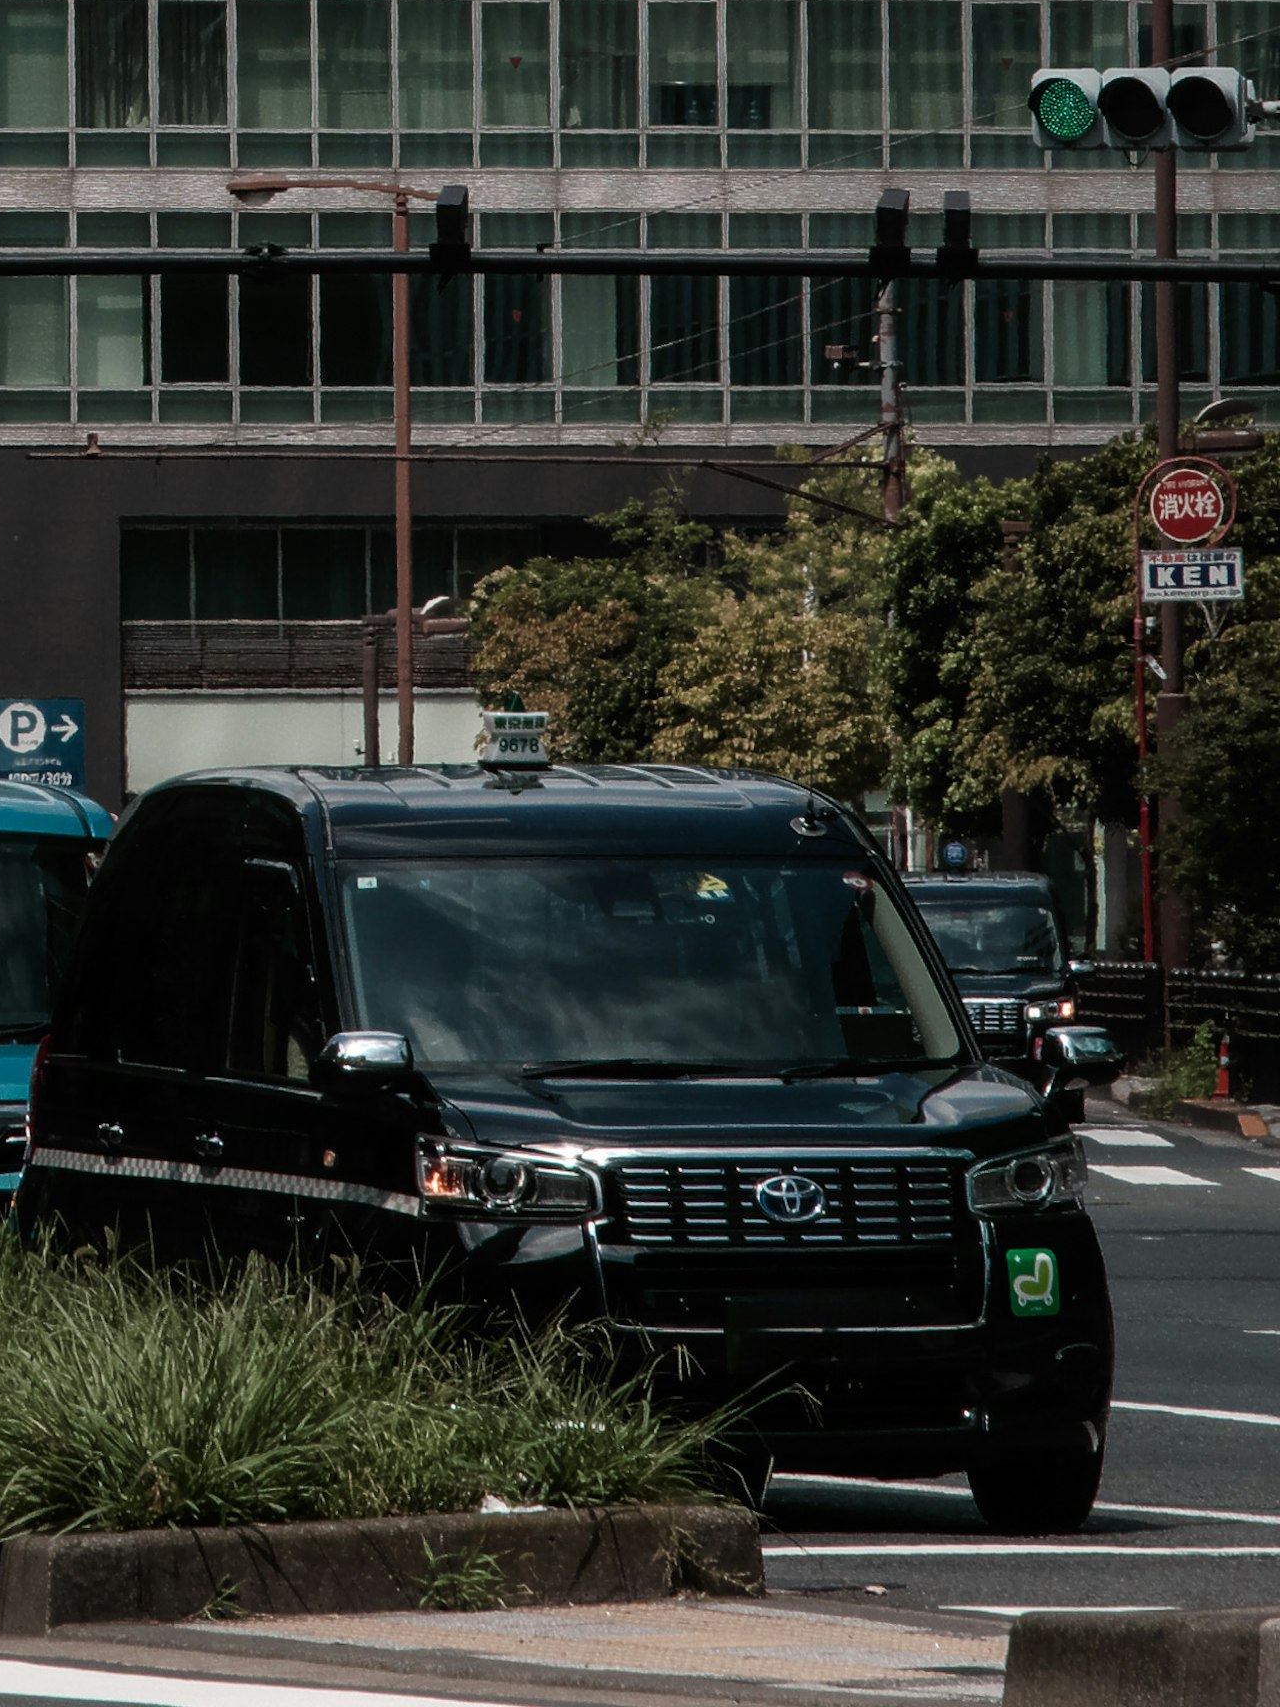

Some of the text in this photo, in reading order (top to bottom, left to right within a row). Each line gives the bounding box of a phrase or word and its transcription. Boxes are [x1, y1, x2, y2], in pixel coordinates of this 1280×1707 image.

[1158, 491, 1217, 520] 消火栓
[1156, 565, 1229, 587] KEN
[10, 710, 37, 747] P
[499, 737, 539, 753] 9678
